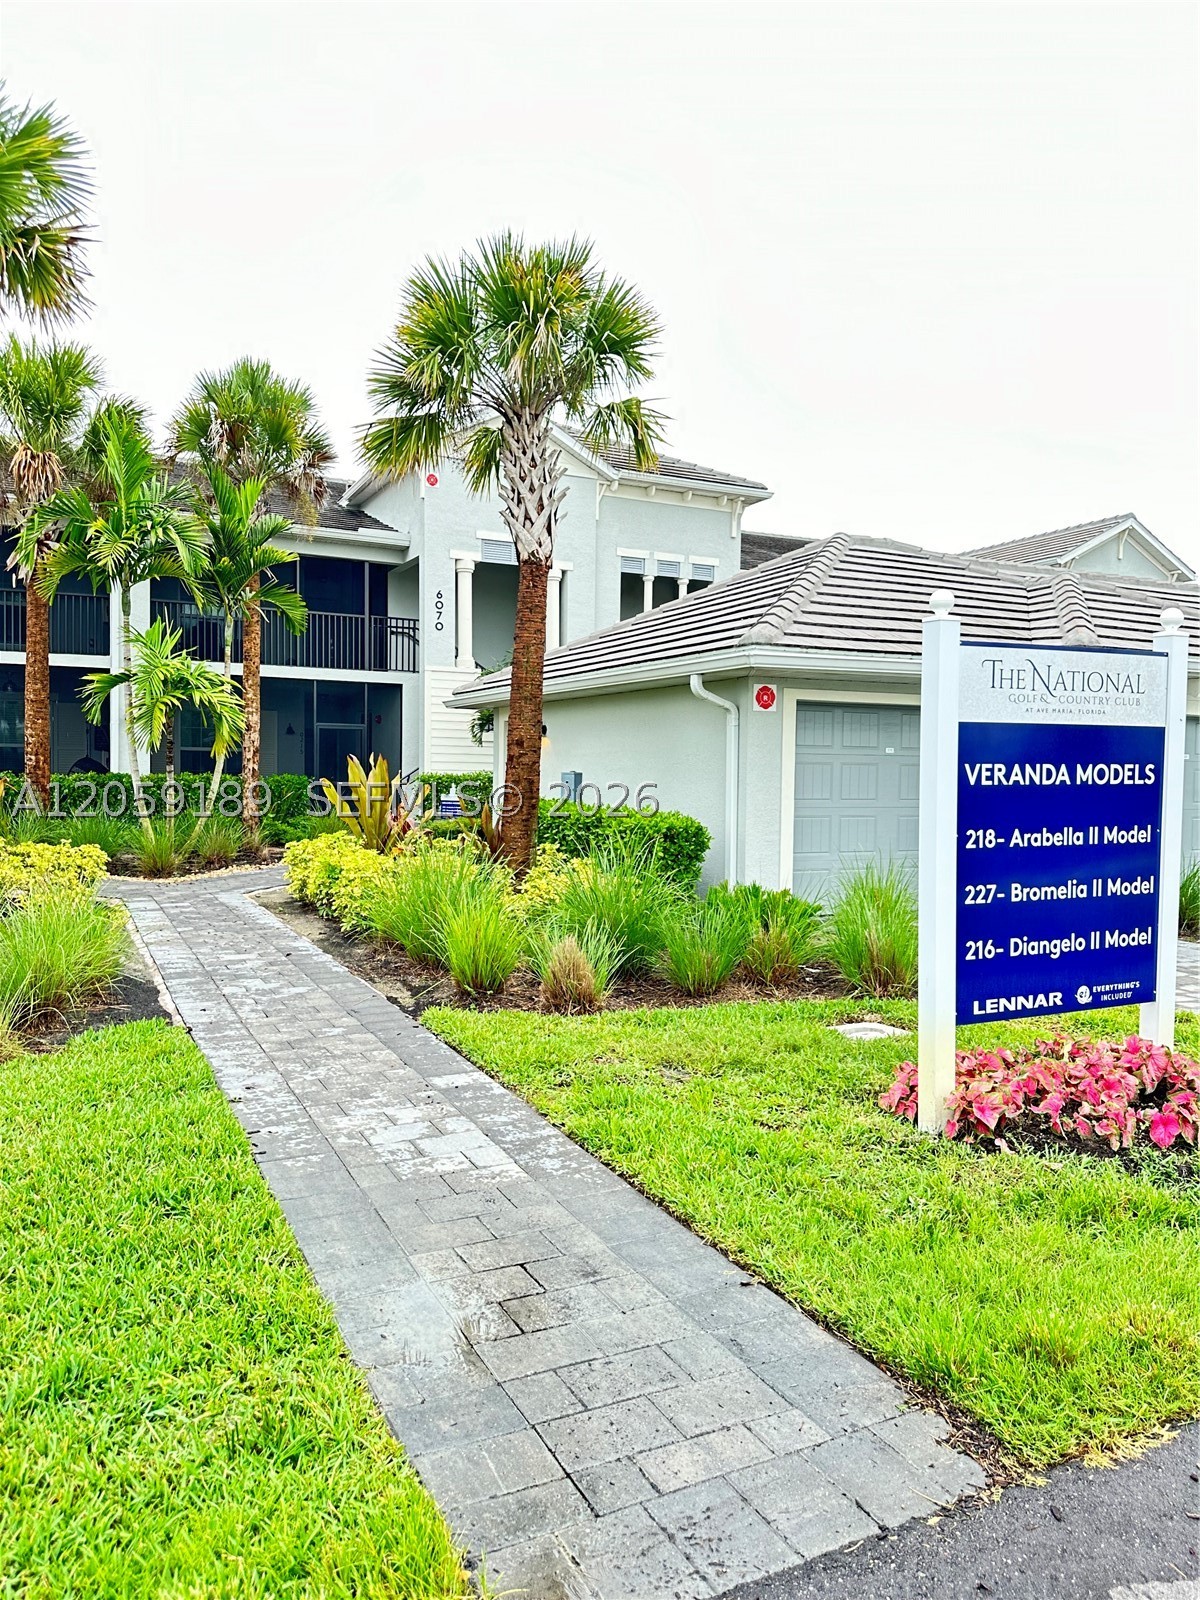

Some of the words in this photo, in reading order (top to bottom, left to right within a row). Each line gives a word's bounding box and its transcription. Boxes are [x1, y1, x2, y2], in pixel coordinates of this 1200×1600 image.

[435, 590, 444, 631] 6070
[1008, 693, 1038, 705] GOLF
[1039, 693, 1051, 704] &
[1058, 695, 1111, 705] COUNTRY
[1114, 696, 1141, 706] CLUB
[965, 764, 1071, 785] VERANDA
[1077, 764, 1155, 784] MODELS
[966, 829, 1004, 848] 218-
[1010, 827, 1083, 847] Arabella
[1089, 827, 1098, 844] II
[1104, 825, 1151, 844] Model
[965, 884, 1005, 904] 227-
[1011, 879, 1087, 902] Bromelia
[1093, 879, 1102, 897] II
[1108, 876, 1154, 896] Model
[966, 940, 1003, 960] 216-
[1010, 933, 1085, 959] Diangelo
[1091, 931, 1099, 949] II
[1105, 927, 1151, 948] Model
[973, 992, 1064, 1015] LENNAR
